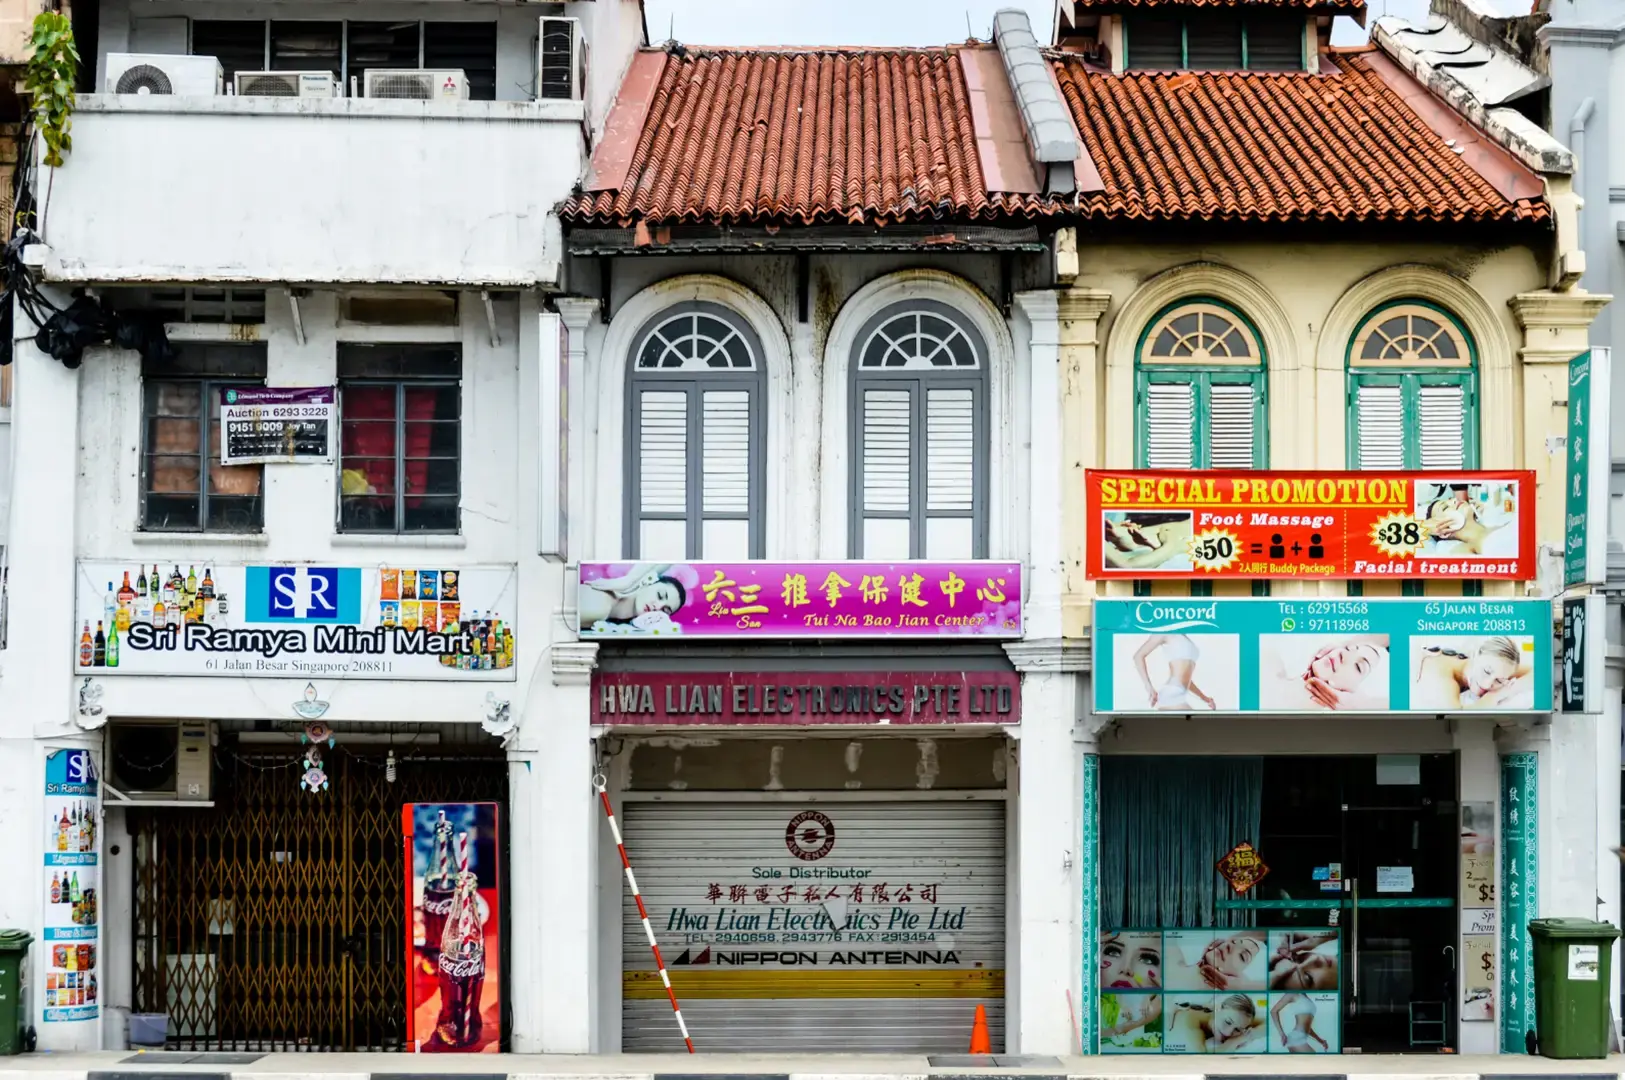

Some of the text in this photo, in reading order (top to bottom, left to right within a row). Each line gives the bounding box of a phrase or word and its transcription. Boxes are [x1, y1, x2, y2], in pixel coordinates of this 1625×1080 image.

[227, 407, 329, 418] Auction 6293 3228
[229, 422, 254, 432] 9151
[255, 421, 284, 432] 9009
[302, 422, 316, 430] Tan
[1101, 478, 1408, 504] SPECIAL PROMOTION
[1199, 512, 1334, 529] Foot Massage
[1378, 522, 1420, 545] $38
[1194, 537, 1233, 561] $50
[1269, 563, 1298, 576] Buddy
[1300, 562, 1336, 576] Package
[1353, 560, 1518, 574] Facial treatment
[1135, 602, 1218, 624] Concord
[1307, 602, 1368, 615] 62915568
[1425, 603, 1514, 618] 65 JALAN BESAR
[736, 615, 762, 629] San
[803, 613, 985, 628] Tui Na Bao Jian Center
[1309, 619, 1369, 631] 97118968
[1417, 619, 1526, 632] SINGAPORE 208813
[129, 623, 472, 658] Sri Ramya Mini Mart
[205, 659, 393, 673] 61 Jalan Besar Singapore 208811
[599, 683, 1012, 714] HWA LIAN ELECTRONICS PTE LTD
[47, 783, 59, 793] Sri
[790, 811, 830, 828] NIPPON
[786, 840, 834, 861] ANTENNA
[1235, 851, 1255, 868] 福
[752, 866, 872, 879] Sole Distributor
[1466, 871, 1473, 880] 2
[666, 906, 967, 931] Hwa Lian Electrnics Pte Ltd
[716, 951, 960, 965] NIPPON ANTENNA
